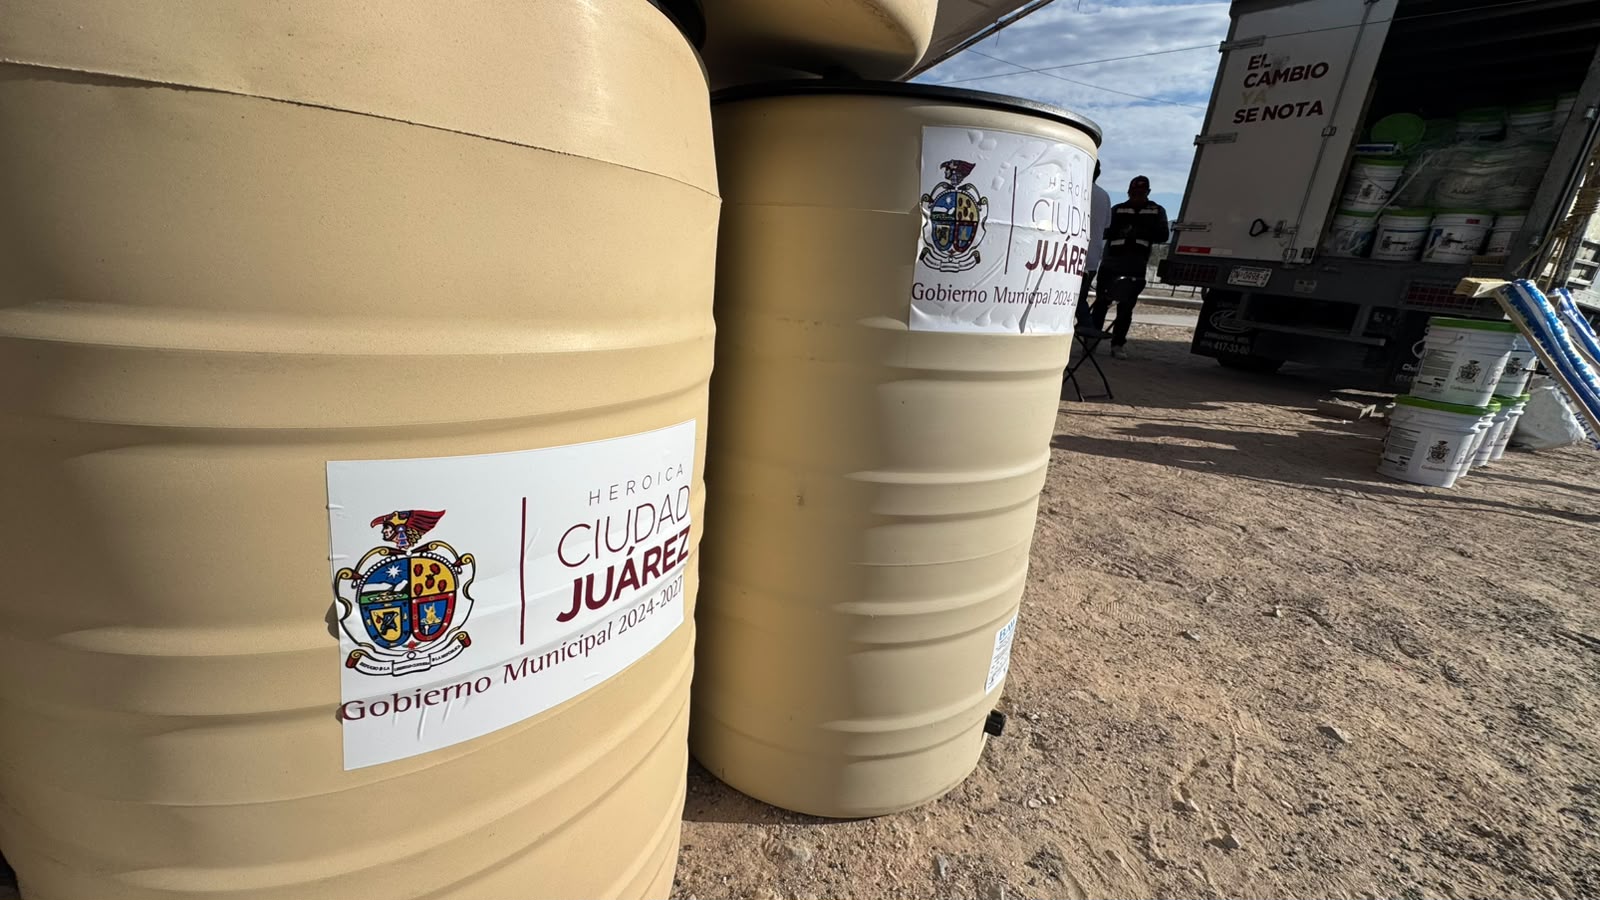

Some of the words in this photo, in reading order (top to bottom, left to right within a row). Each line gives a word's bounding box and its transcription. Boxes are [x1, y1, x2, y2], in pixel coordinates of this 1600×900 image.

[1243, 62, 1329, 88] CAMBIO
[1248, 53, 1272, 70] EL
[1232, 107, 1259, 124] SE
[1262, 100, 1323, 121] NOTA
[1025, 236, 1088, 277] JUÁRE
[912, 282, 988, 303] Gobierno
[993, 286, 1051, 308] Municipal
[588, 462, 685, 506] HEROICA
[557, 485, 691, 568] CIUDAD
[556, 524, 691, 623] JUÁREZ
[341, 676, 492, 722] Gobierno
[503, 623, 613, 685] Municipal
[617, 574, 684, 636] 2024-2027
